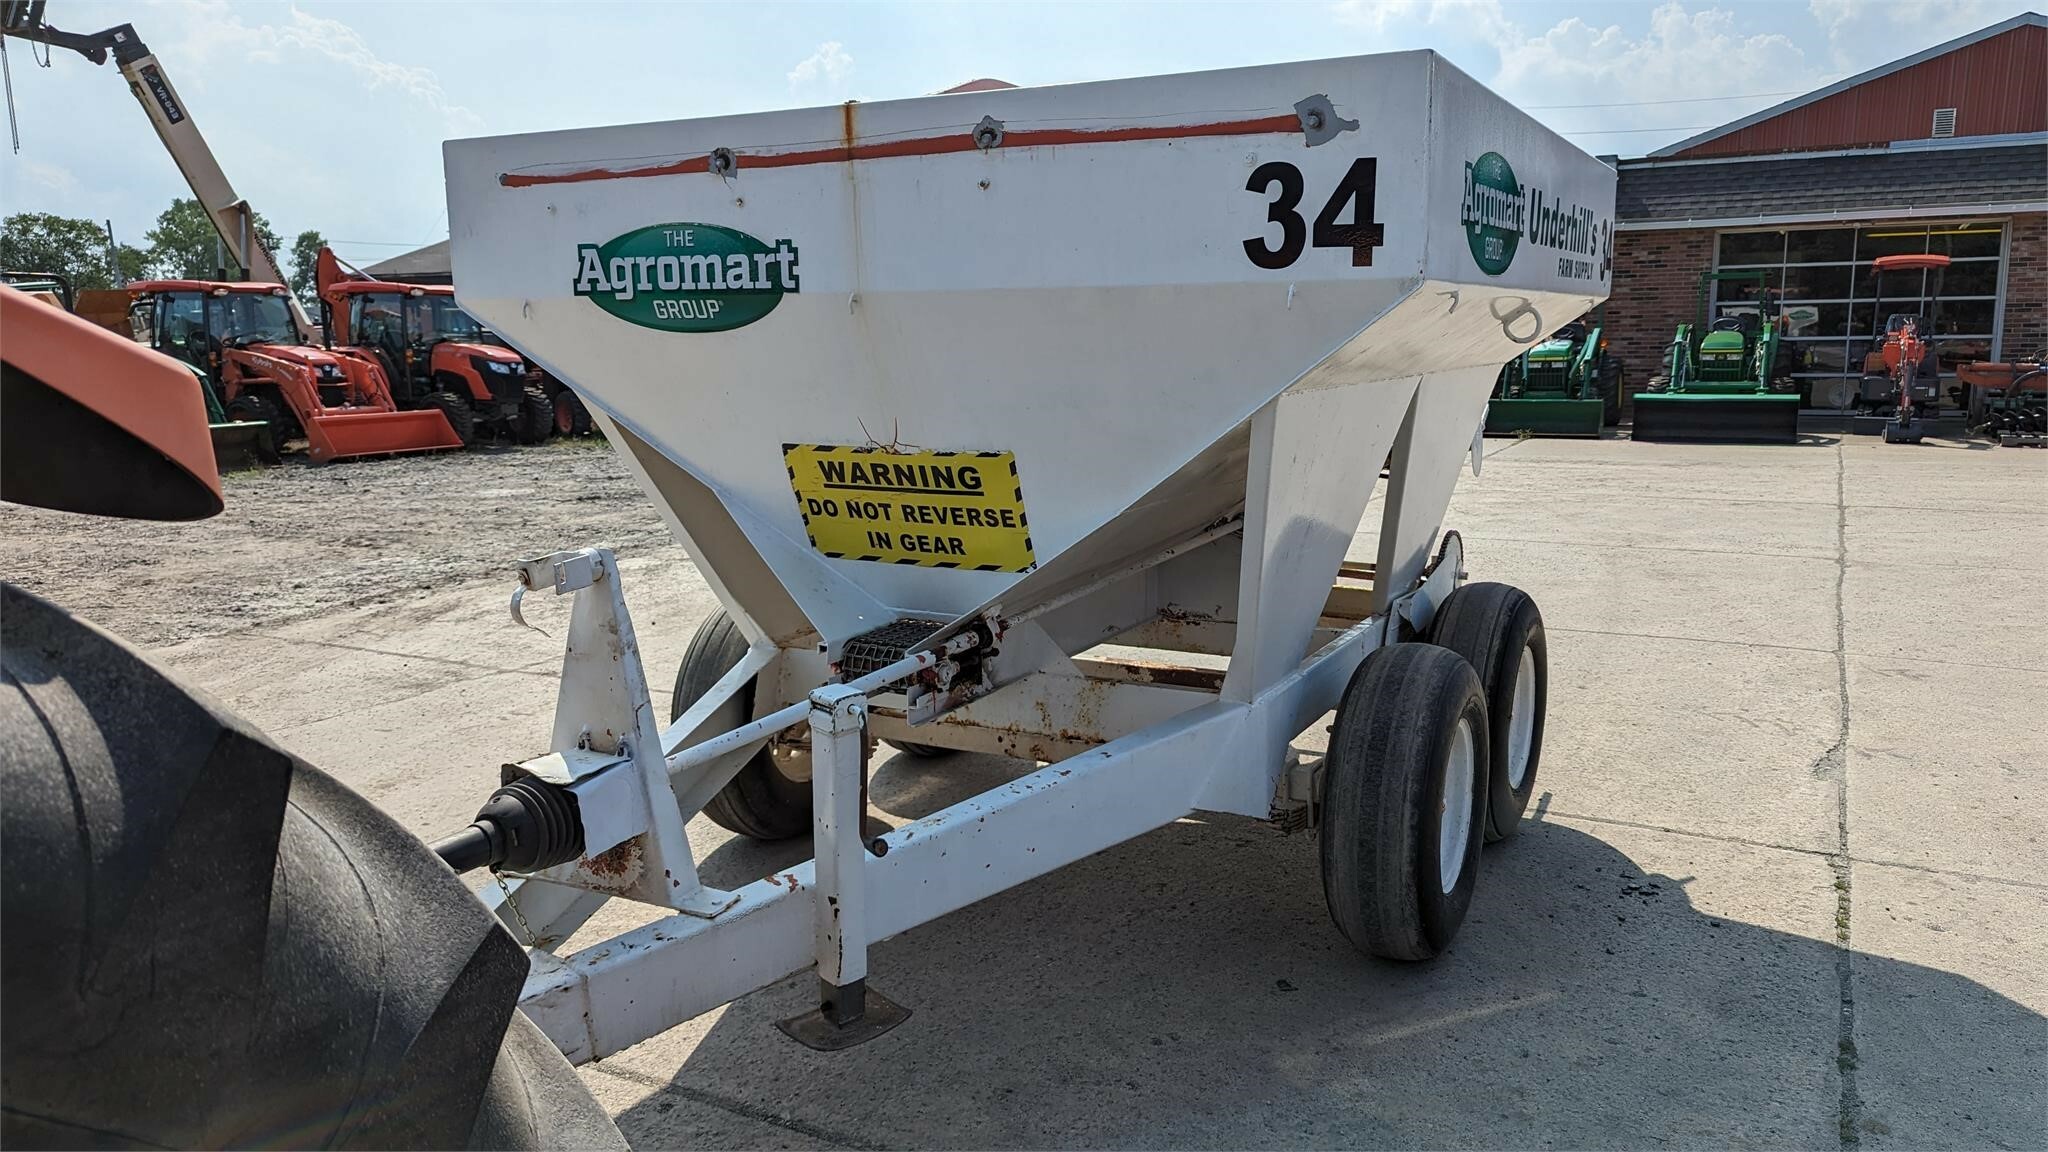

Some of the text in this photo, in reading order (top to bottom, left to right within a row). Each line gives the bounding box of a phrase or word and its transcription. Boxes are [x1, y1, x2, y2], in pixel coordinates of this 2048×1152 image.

[1242, 157, 1384, 269] 34
[1462, 165, 1526, 235] Agromart
[663, 229, 695, 248] THE
[1529, 188, 1614, 282] Underhill's 34
[575, 243, 796, 300] Agromart
[1557, 257, 1594, 281] FARM SUPPLY
[653, 300, 720, 319] GROUP
[817, 460, 983, 490] WARNING
[807, 498, 1016, 528] DO NOT REVERSE
[867, 531, 967, 556] IN GEAR
